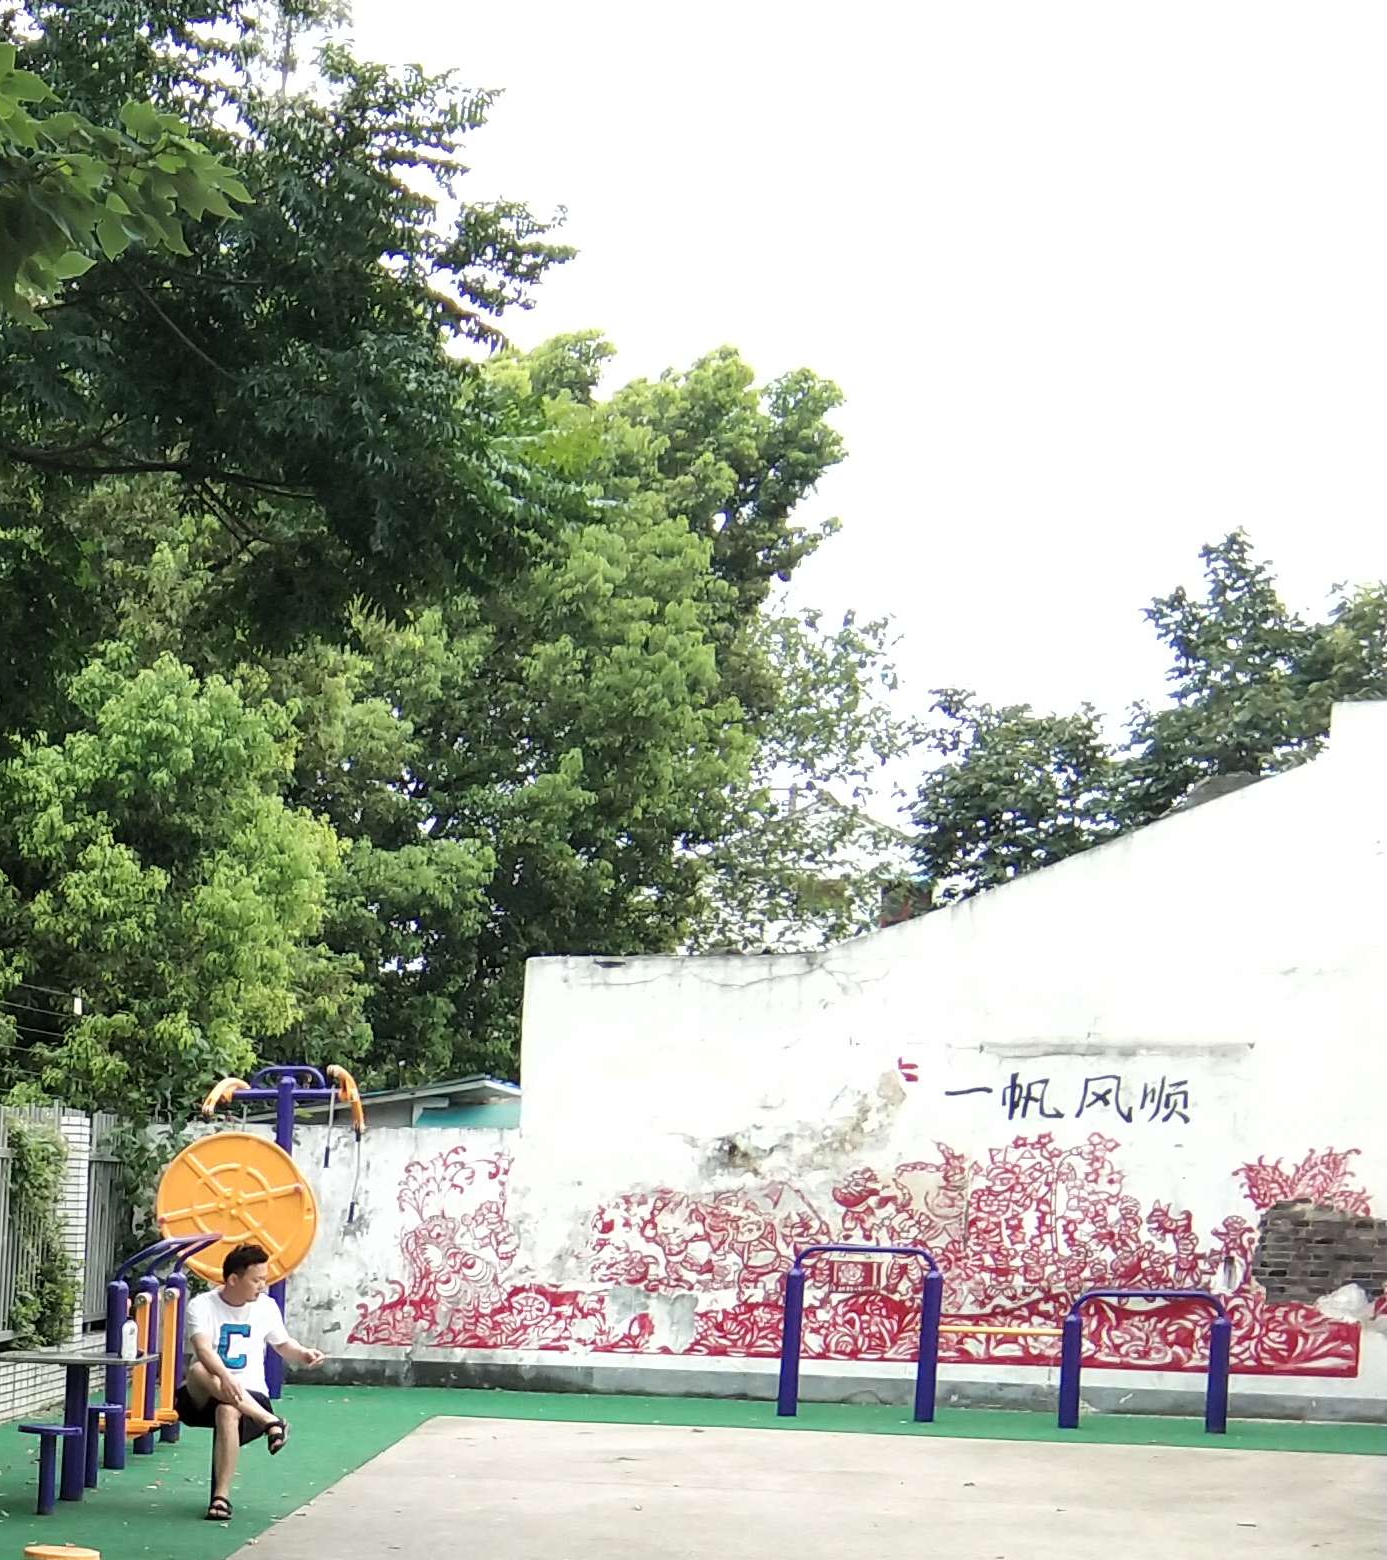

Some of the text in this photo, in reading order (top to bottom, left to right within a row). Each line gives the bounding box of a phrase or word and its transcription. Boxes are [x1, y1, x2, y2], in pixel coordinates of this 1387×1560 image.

[944, 1072, 1191, 1125] 一帆风顺
[218, 1323, 251, 1370] C
